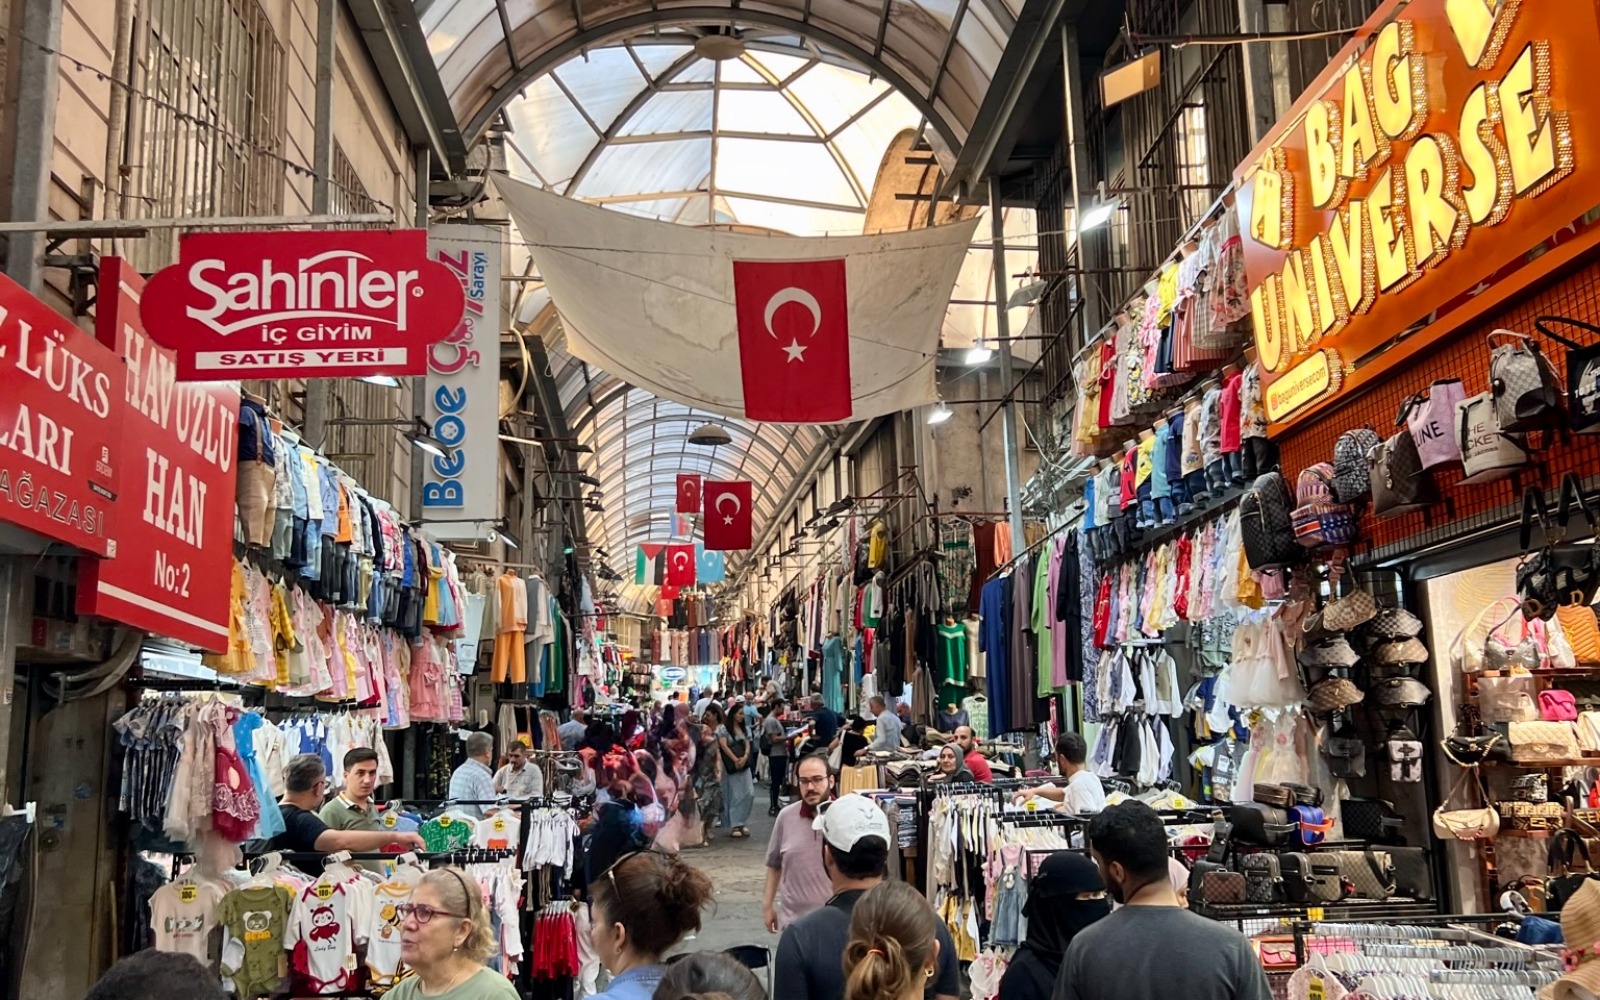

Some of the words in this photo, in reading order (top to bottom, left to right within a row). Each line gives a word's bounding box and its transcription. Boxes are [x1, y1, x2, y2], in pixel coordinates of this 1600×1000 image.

[1304, 20, 1418, 209] BAG
[1251, 42, 1564, 371] UNIVERSE
[15, 319, 110, 419] LÜKS
[219, 351, 305, 366] SATIŞ
[316, 348, 385, 363] YERİ
[261, 324, 287, 345] İÇ
[296, 322, 372, 341] GİYİM
[143, 447, 207, 550] HAN
[154, 550, 190, 599] No:2
